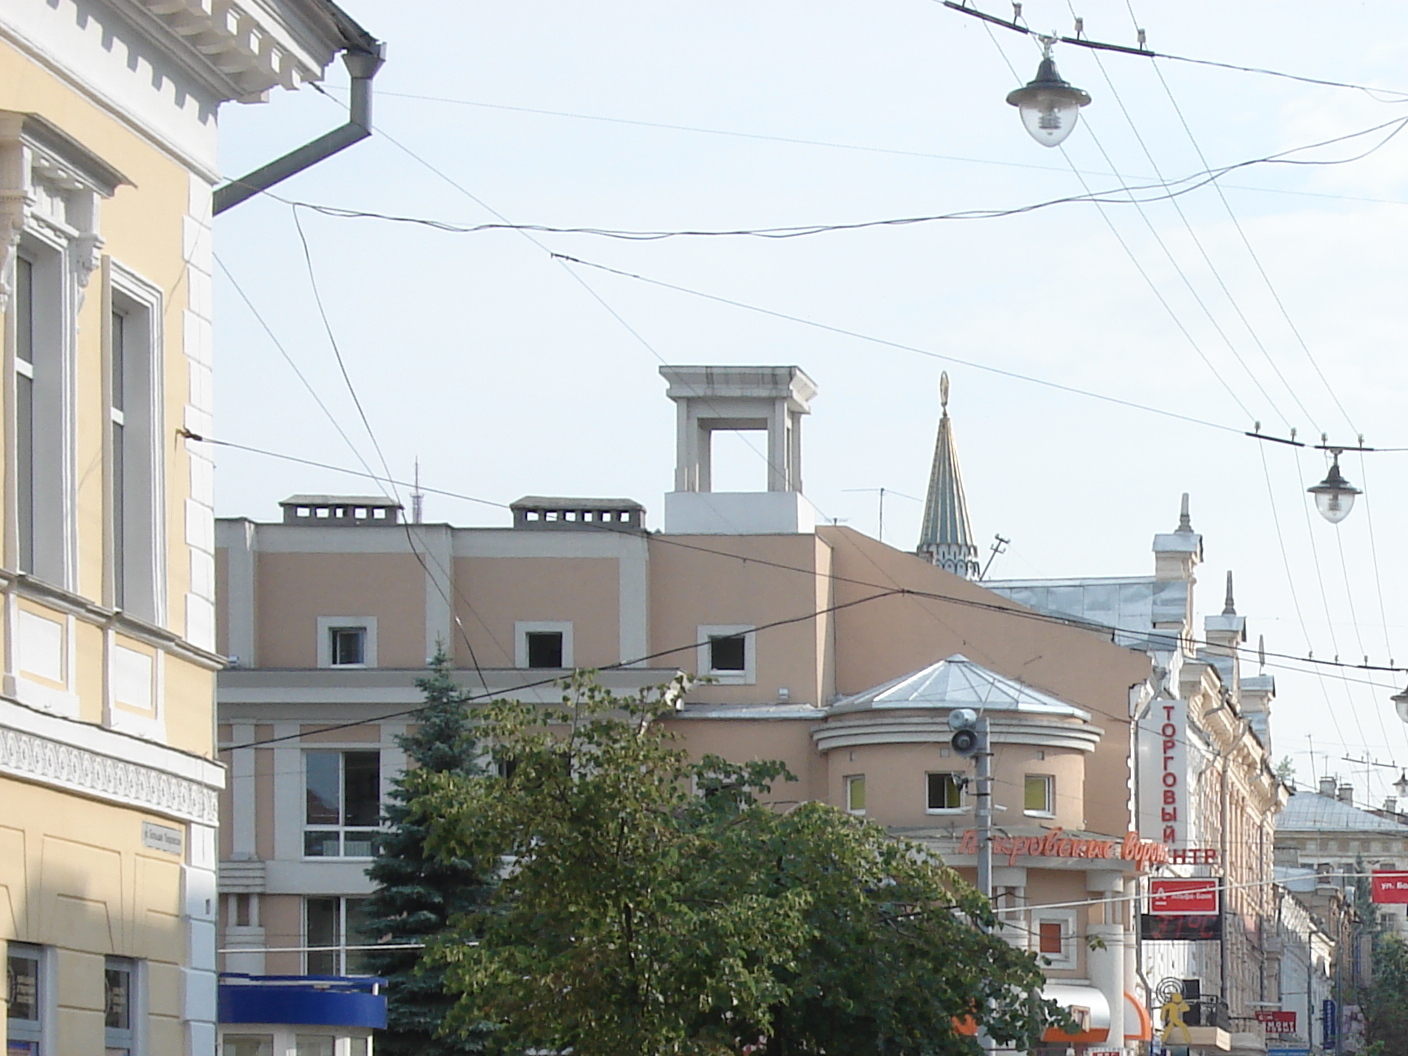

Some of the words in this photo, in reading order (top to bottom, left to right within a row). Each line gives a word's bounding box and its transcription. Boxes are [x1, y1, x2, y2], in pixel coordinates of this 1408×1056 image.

[1161, 705, 1177, 843] ТОРГОВЫЙ
[958, 826, 1114, 867] Пкровские
[1172, 849, 1218, 865] НТР
